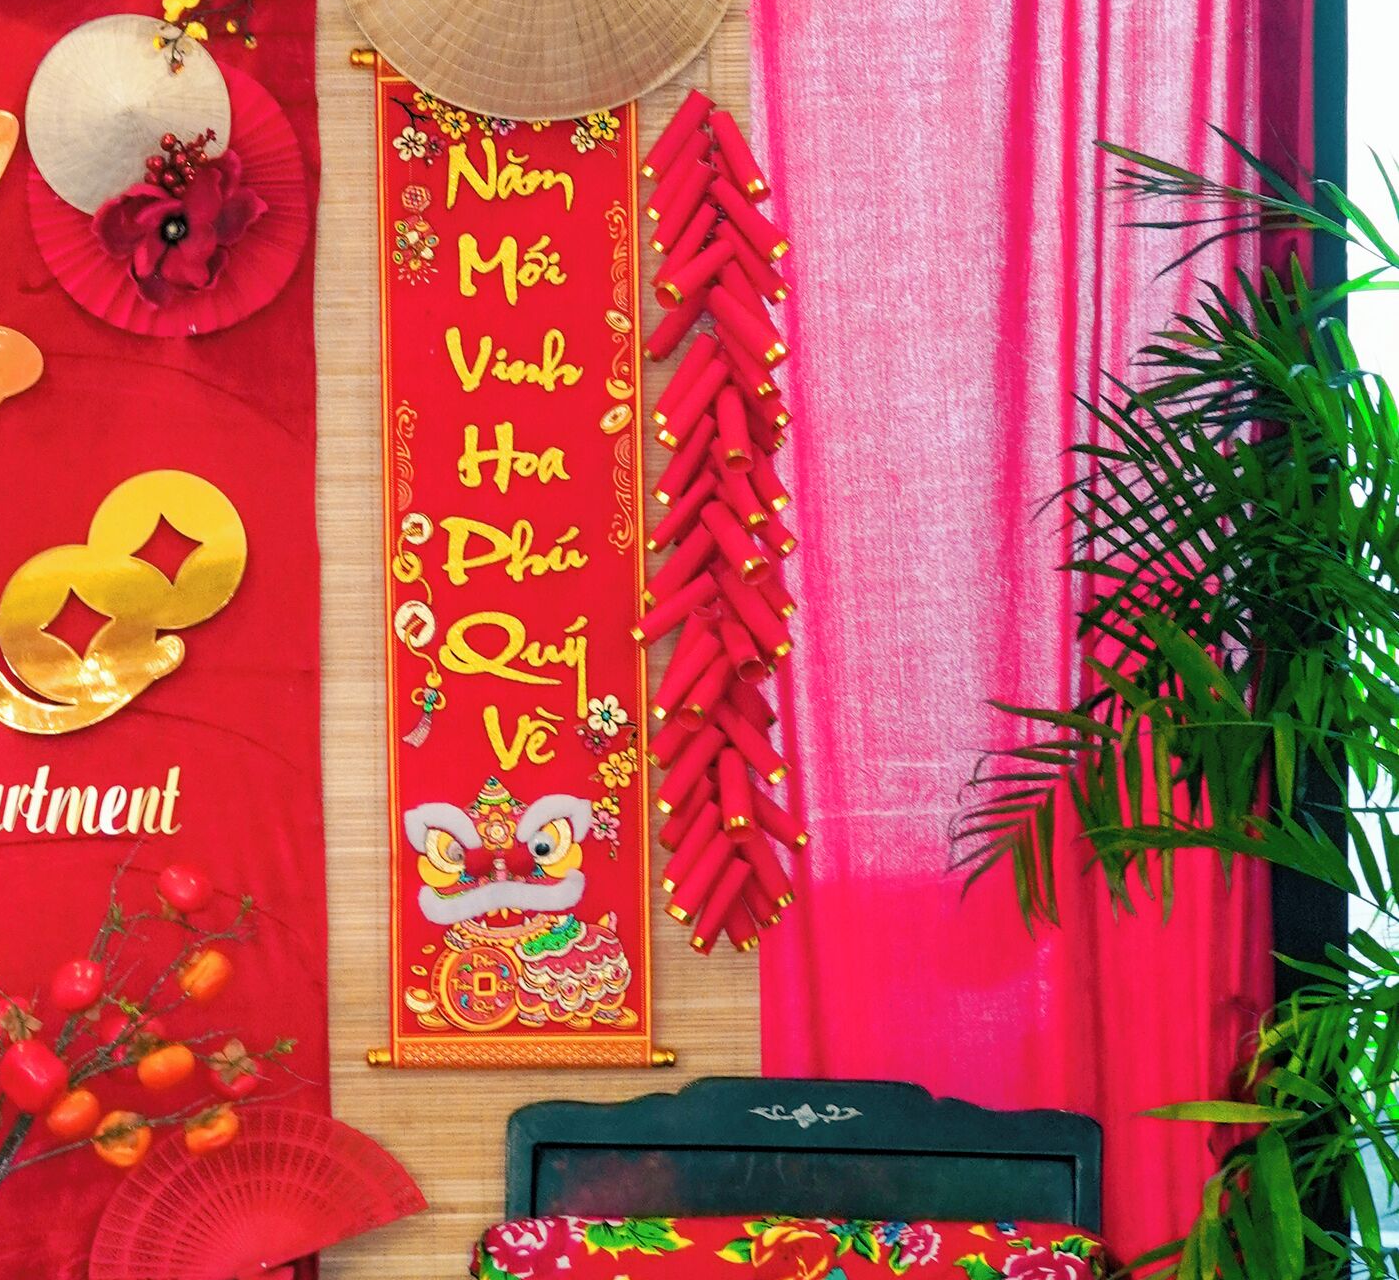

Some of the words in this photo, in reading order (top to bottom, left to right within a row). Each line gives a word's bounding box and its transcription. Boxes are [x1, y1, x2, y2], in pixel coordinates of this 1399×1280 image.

[446, 136, 574, 211] Năm
[458, 232, 567, 306] Mới
[445, 326, 584, 394] Vinh
[457, 421, 571, 494] Hoa
[439, 516, 590, 587] Phú
[438, 611, 589, 719] Quý
[483, 705, 564, 771] Về
